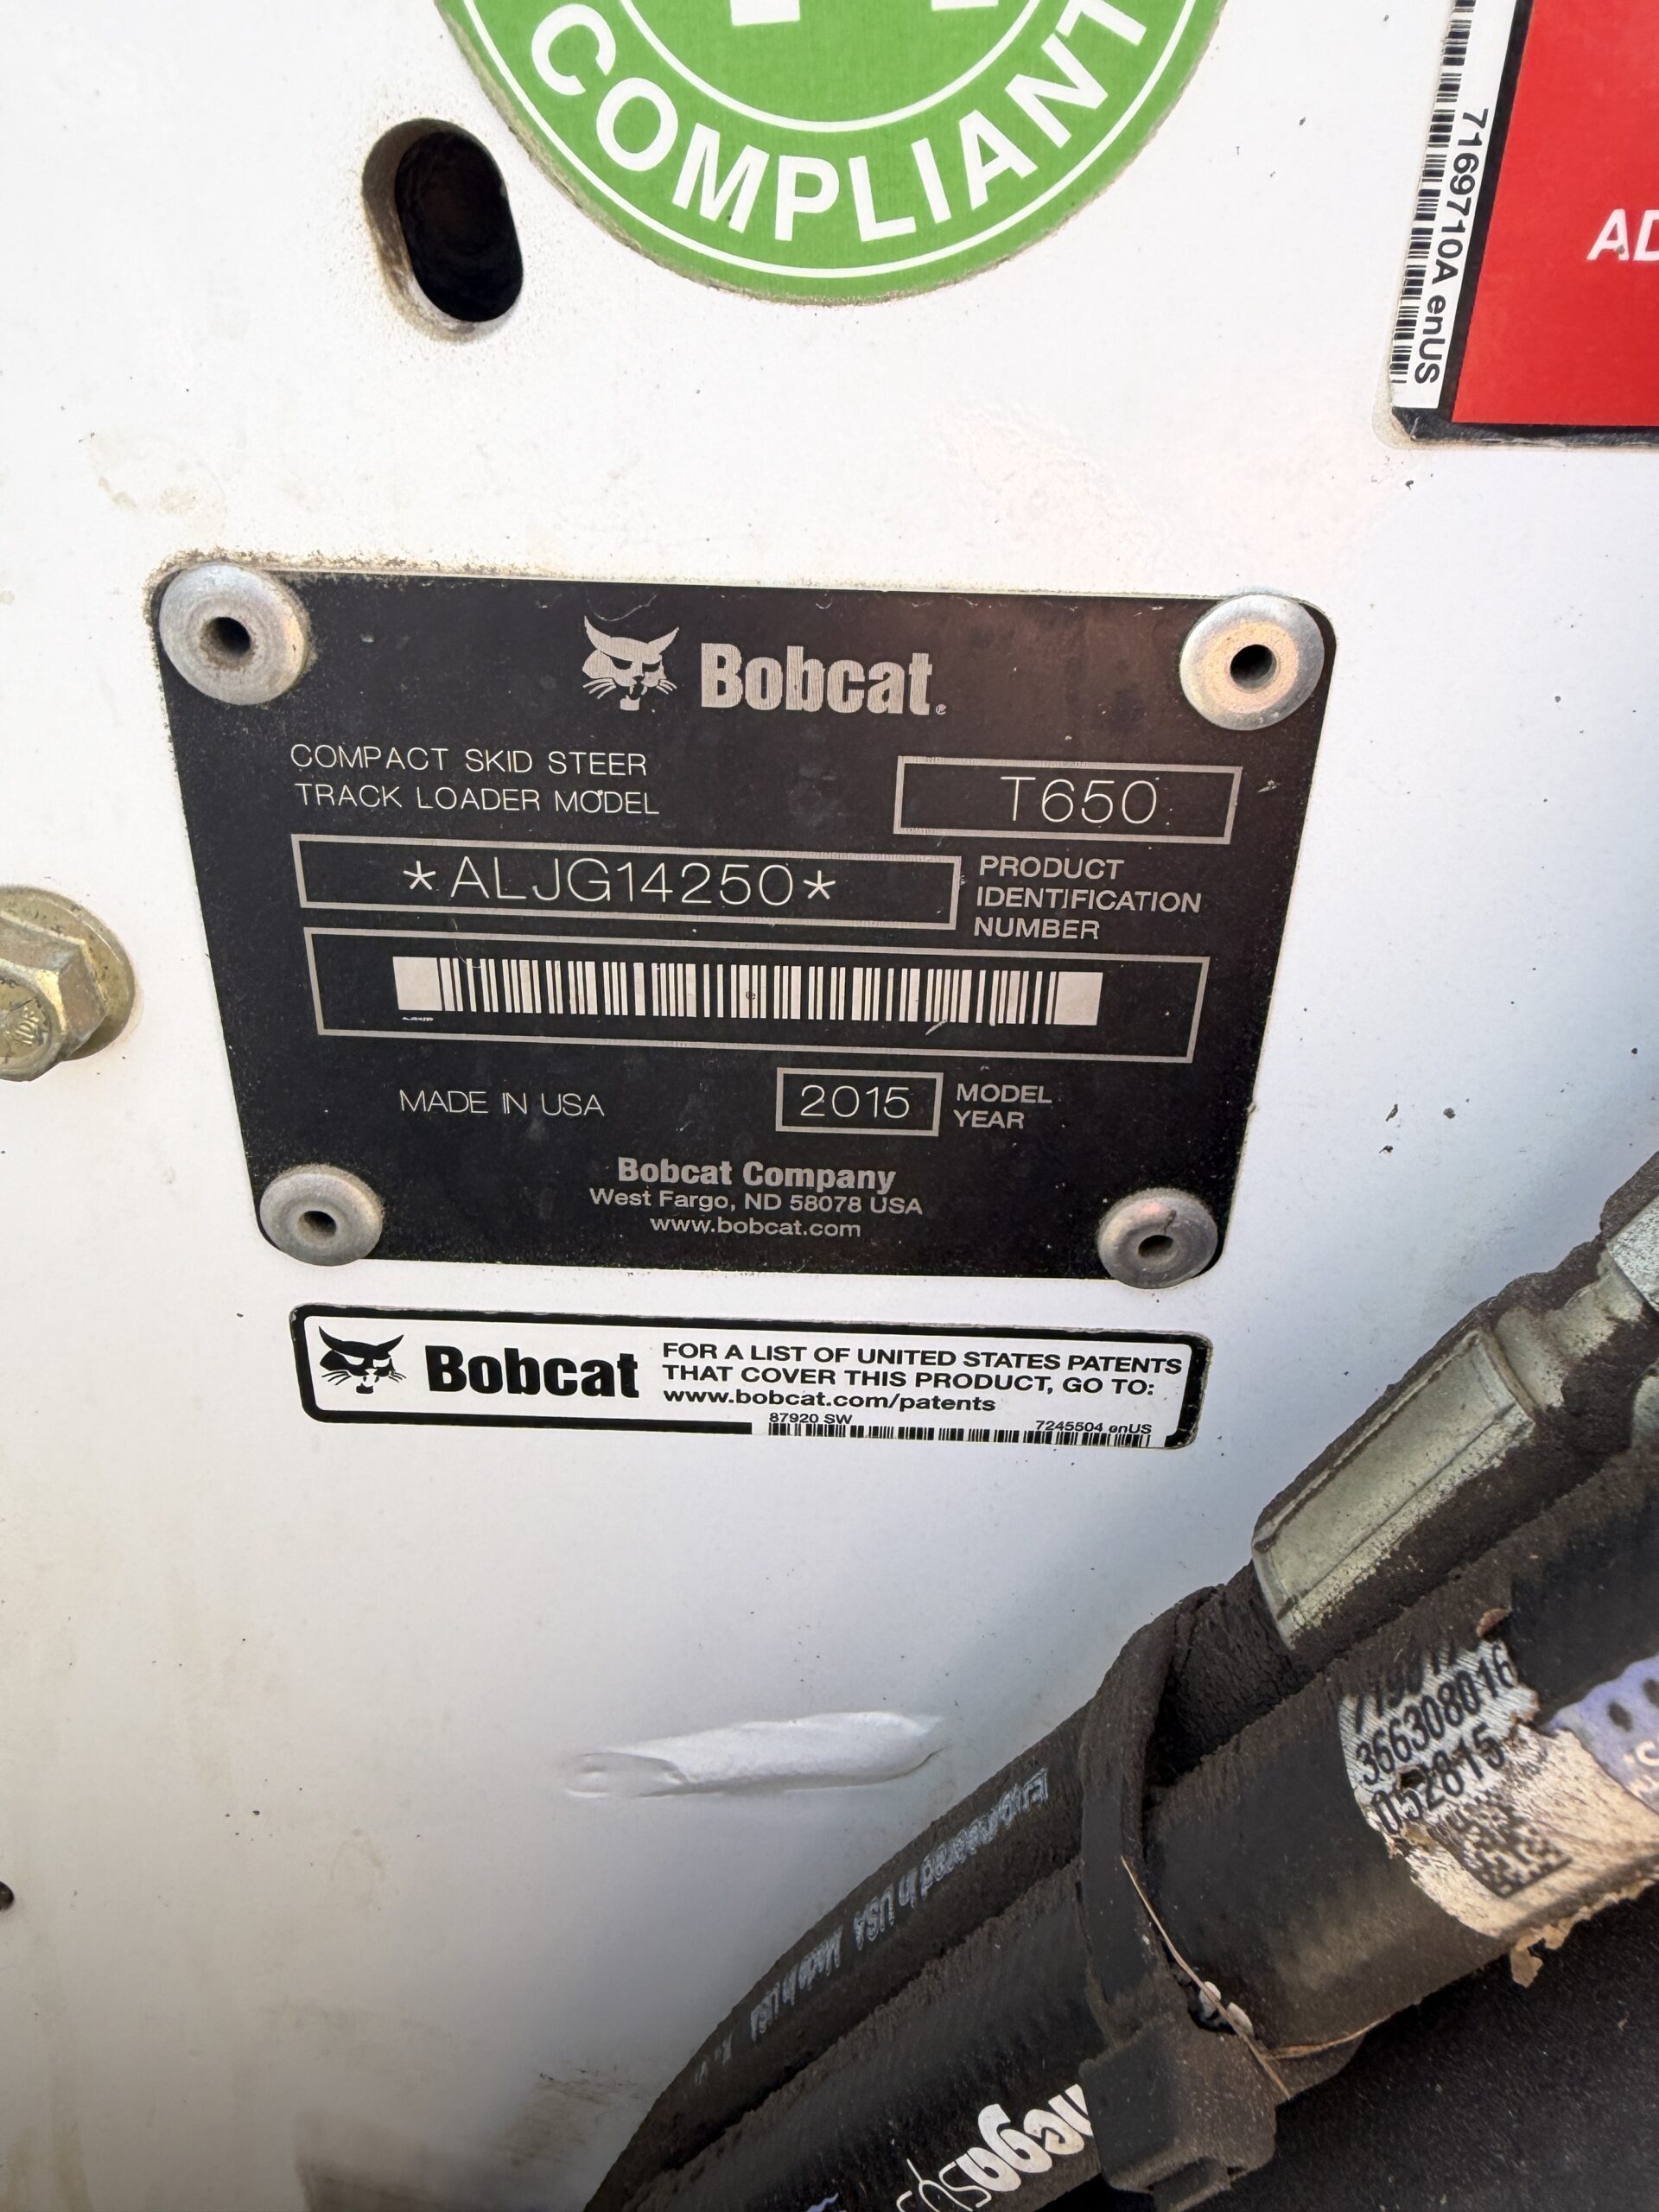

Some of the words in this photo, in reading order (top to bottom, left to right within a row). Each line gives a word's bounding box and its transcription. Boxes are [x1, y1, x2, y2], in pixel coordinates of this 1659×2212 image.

[531, 0, 1147, 241] COMPLIANT
[1431, 108, 1489, 283] 7169710A
[1414, 295, 1446, 385] enUS
[701, 643, 932, 715] Bobcat
[290, 744, 448, 772] COMPACT
[465, 749, 533, 774] SKID
[548, 751, 647, 776] STEER
[295, 784, 402, 808] TRACK
[416, 787, 540, 812] LOADER
[555, 790, 659, 815] MODEL
[1001, 776, 1158, 824] T650
[979, 855, 1124, 880] PRODUCT
[976, 887, 1202, 913] IDENTIFICATION
[974, 918, 1100, 941] NUMBER
[399, 1089, 488, 1115] MADE
[501, 1091, 528, 1116] IN
[541, 1092, 605, 1117] USA
[799, 1084, 912, 1121] 2015
[956, 1084, 1052, 1105] MODEL
[953, 1109, 1026, 1130] YEAR
[617, 1156, 732, 1187] Bobcat
[742, 1161, 896, 1194] Company
[588, 1187, 652, 1208] West
[659, 1191, 735, 1212] Fargo,
[744, 1192, 782, 1211] ND
[789, 1194, 862, 1214] 58078
[869, 1197, 924, 1216] USA
[650, 1214, 861, 1237] www.bobcat.com
[425, 1345, 639, 1398] Bobcat
[663, 1342, 718, 1360] FOR
[724, 1344, 744, 1360] A
[750, 1345, 807, 1363] LIST
[815, 1347, 850, 1364] OF
[857, 1348, 957, 1368] UNITED
[963, 1352, 1060, 1371] STATES
[1067, 1356, 1183, 1376] PATENTS
[662, 1364, 734, 1382] THAT
[741, 1367, 836, 1386] COVER
[844, 1370, 908, 1388] THIS
[915, 1372, 1053, 1395] PRODUCT,
[1062, 1377, 1104, 1395] GO
[1111, 1379, 1154, 1396] TO:
[663, 1389, 996, 1412] www.bobcat.com/patents
[769, 1413, 819, 1425] 87920
[824, 1414, 853, 1426] SW
[1035, 1421, 1103, 1433] 7245504
[1109, 1424, 1152, 1434] enUS
